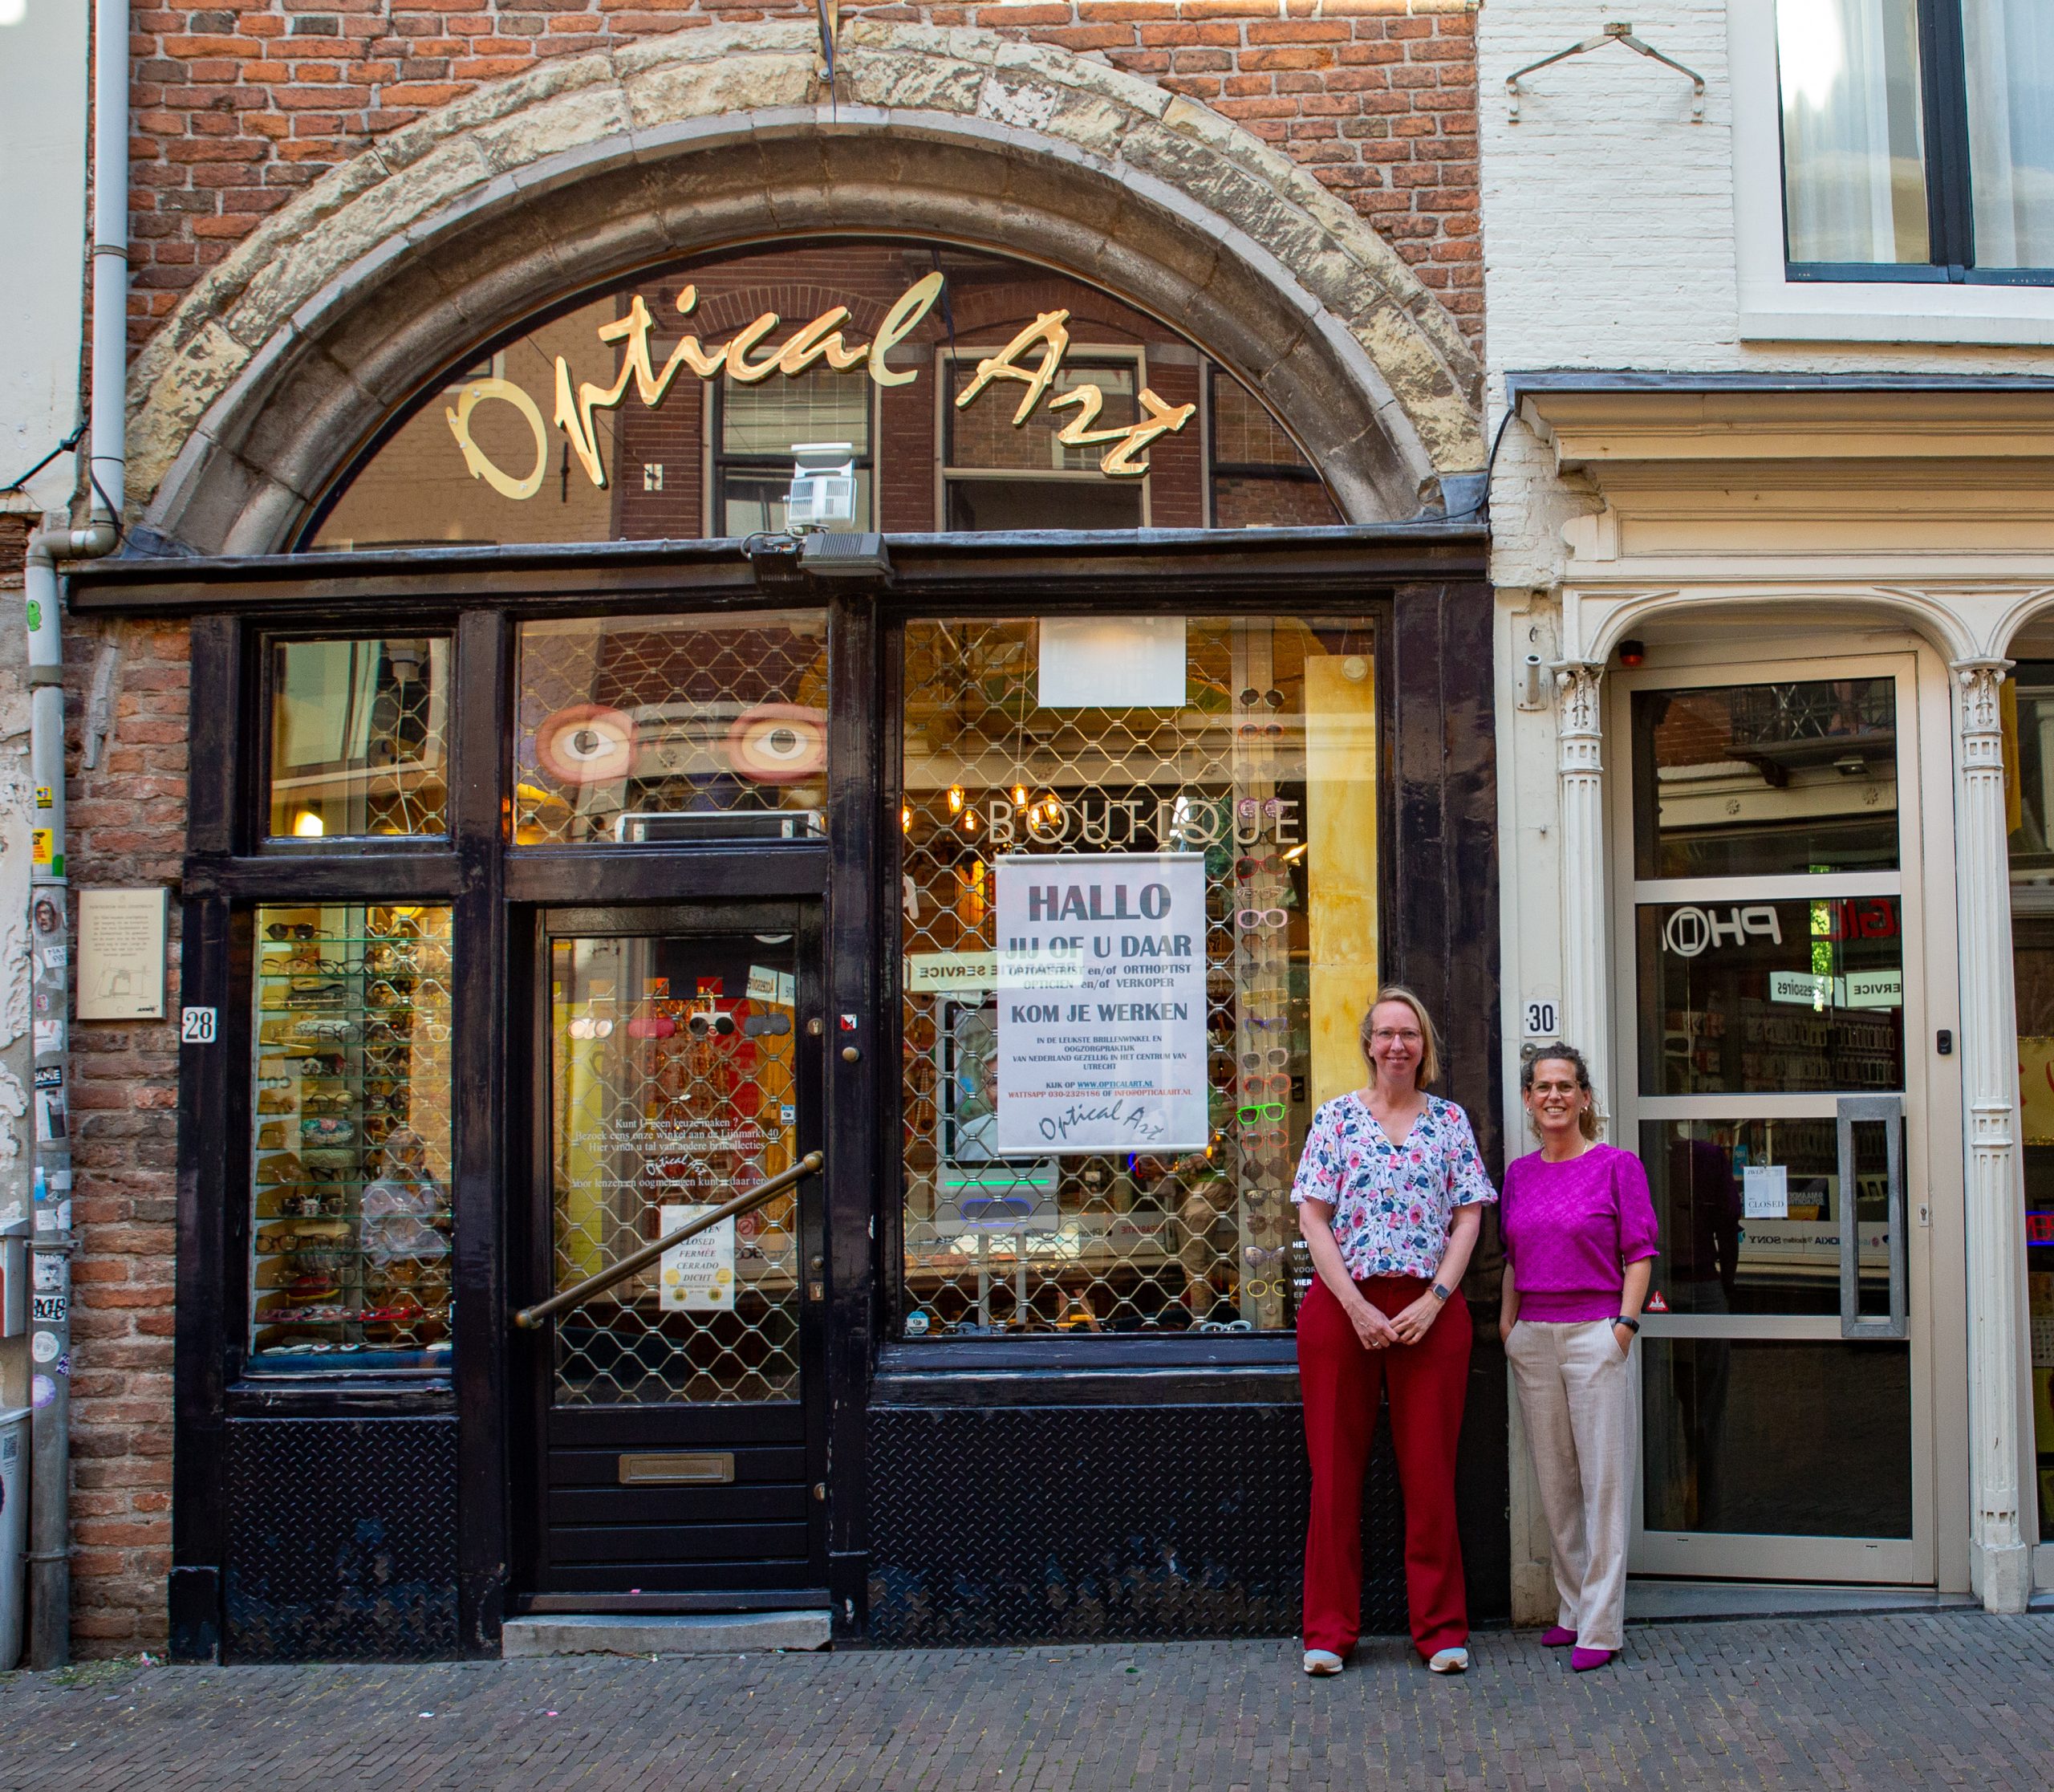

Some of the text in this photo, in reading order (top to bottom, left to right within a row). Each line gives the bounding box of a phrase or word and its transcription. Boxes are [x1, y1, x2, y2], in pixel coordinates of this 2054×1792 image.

[445, 271, 944, 499] Optical
[989, 800, 1299, 844] BOUTIQUE
[1029, 884, 1171, 921] HALLO
[1005, 934, 1192, 960] JIJ OF U DAAR
[1088, 965, 1116, 976] en/of
[1123, 964, 1191, 974] ORTHOPTIST
[1024, 977, 1175, 990] OPTICIEN en/of VERKOPER
[1011, 1002, 1187, 1023] KOM JE WERKEN
[1528, 1004, 1554, 1032] 30
[185, 1011, 213, 1039] 28
[1064, 1045, 1135, 1053] OOGZORGPRAKTIJK
[1077, 1080, 1154, 1089] WWW.OPTICALART.NL
[1114, 1089, 1193, 1097] INFO@OPTICALART.NL
[615, 1119, 637, 1128] Kunt
[650, 1121, 671, 1130] geen
[674, 1119, 699, 1128] keuze
[702, 1118, 730, 1127] maken
[1038, 1099, 1123, 1140] Optical
[575, 1131, 607, 1140] Bezoek
[656, 1130, 687, 1139] winkel
[721, 1129, 765, 1139] Lijnmarkt
[768, 1128, 778, 1137] 40
[589, 1143, 608, 1152] Hier
[611, 1142, 634, 1151] vindt
[645, 1142, 656, 1151] tal
[678, 1141, 706, 1150] andere
[645, 1154, 688, 1175] Optical
[730, 1177, 750, 1185] daar
[1748, 1201, 1784, 1209] CLOSED
[680, 1237, 715, 1245] CLOSED
[679, 1248, 716, 1258] FERMÉE
[676, 1262, 719, 1270] CERRADO
[683, 1274, 712, 1282] DICHT
